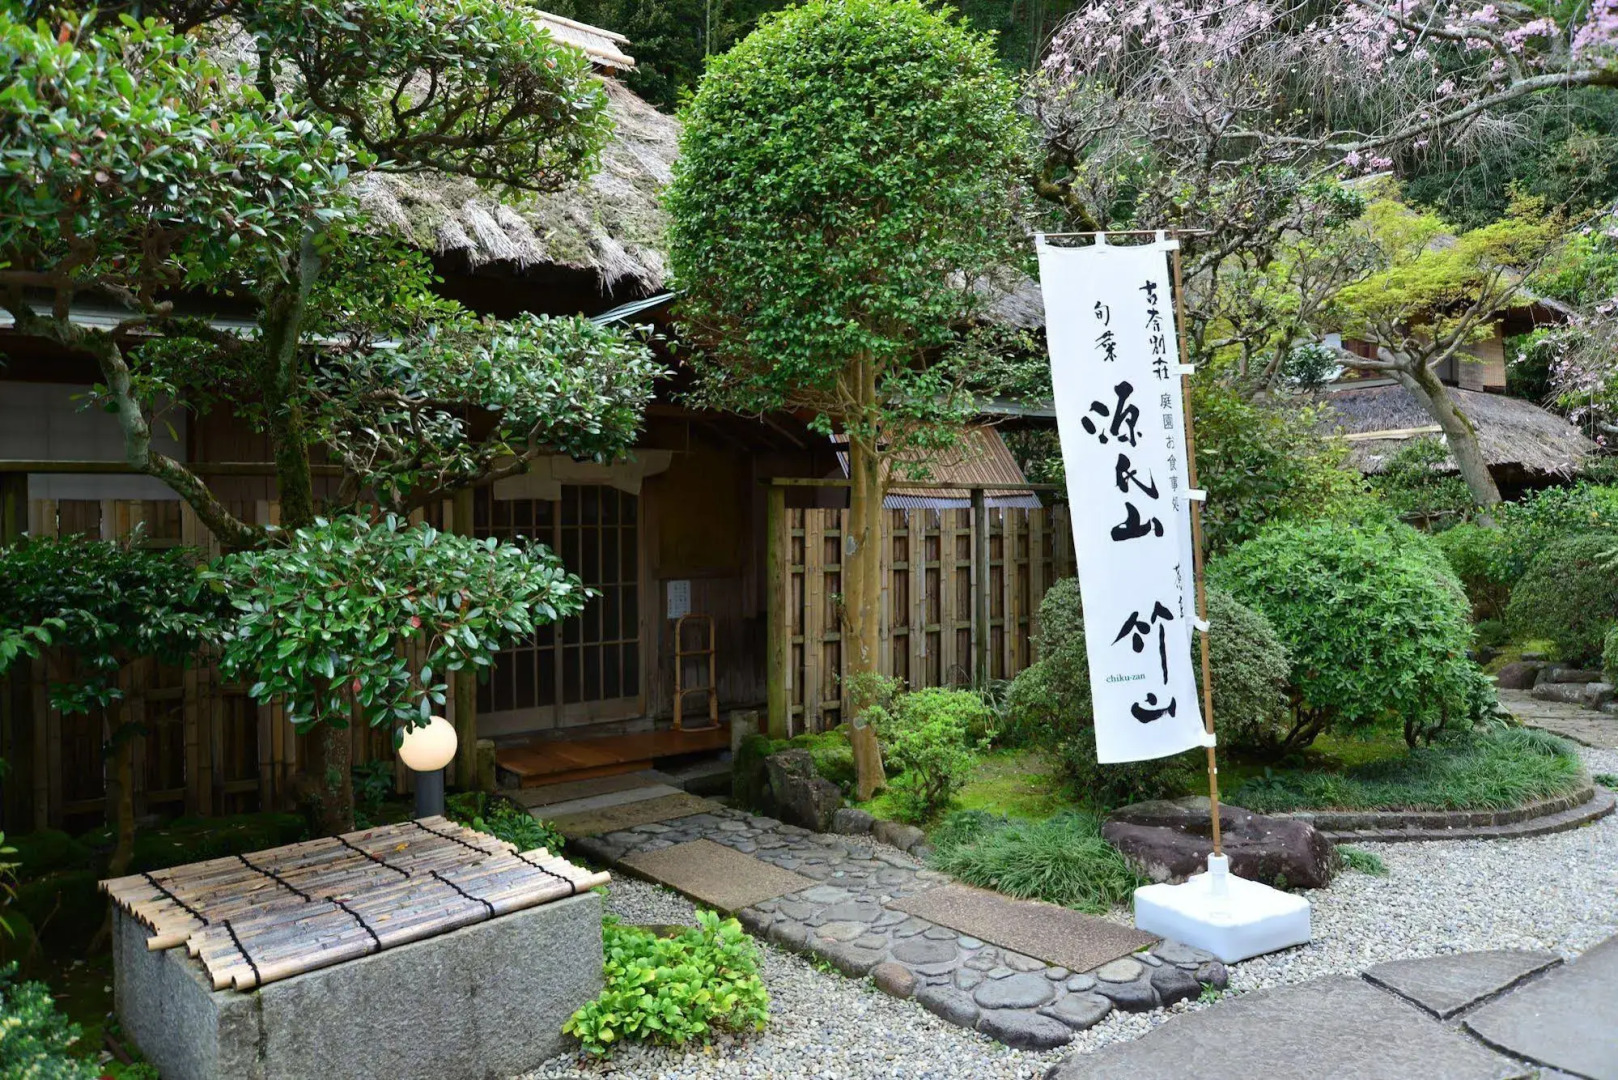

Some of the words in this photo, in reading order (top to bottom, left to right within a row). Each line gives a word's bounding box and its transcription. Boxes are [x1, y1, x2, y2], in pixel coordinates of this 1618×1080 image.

[1094, 301, 1117, 362] 旬菜
[1138, 280, 1170, 380] 古奈別荘
[1160, 393, 1180, 512] 庭園お食事処
[1105, 673, 1146, 683] chiku-zan
